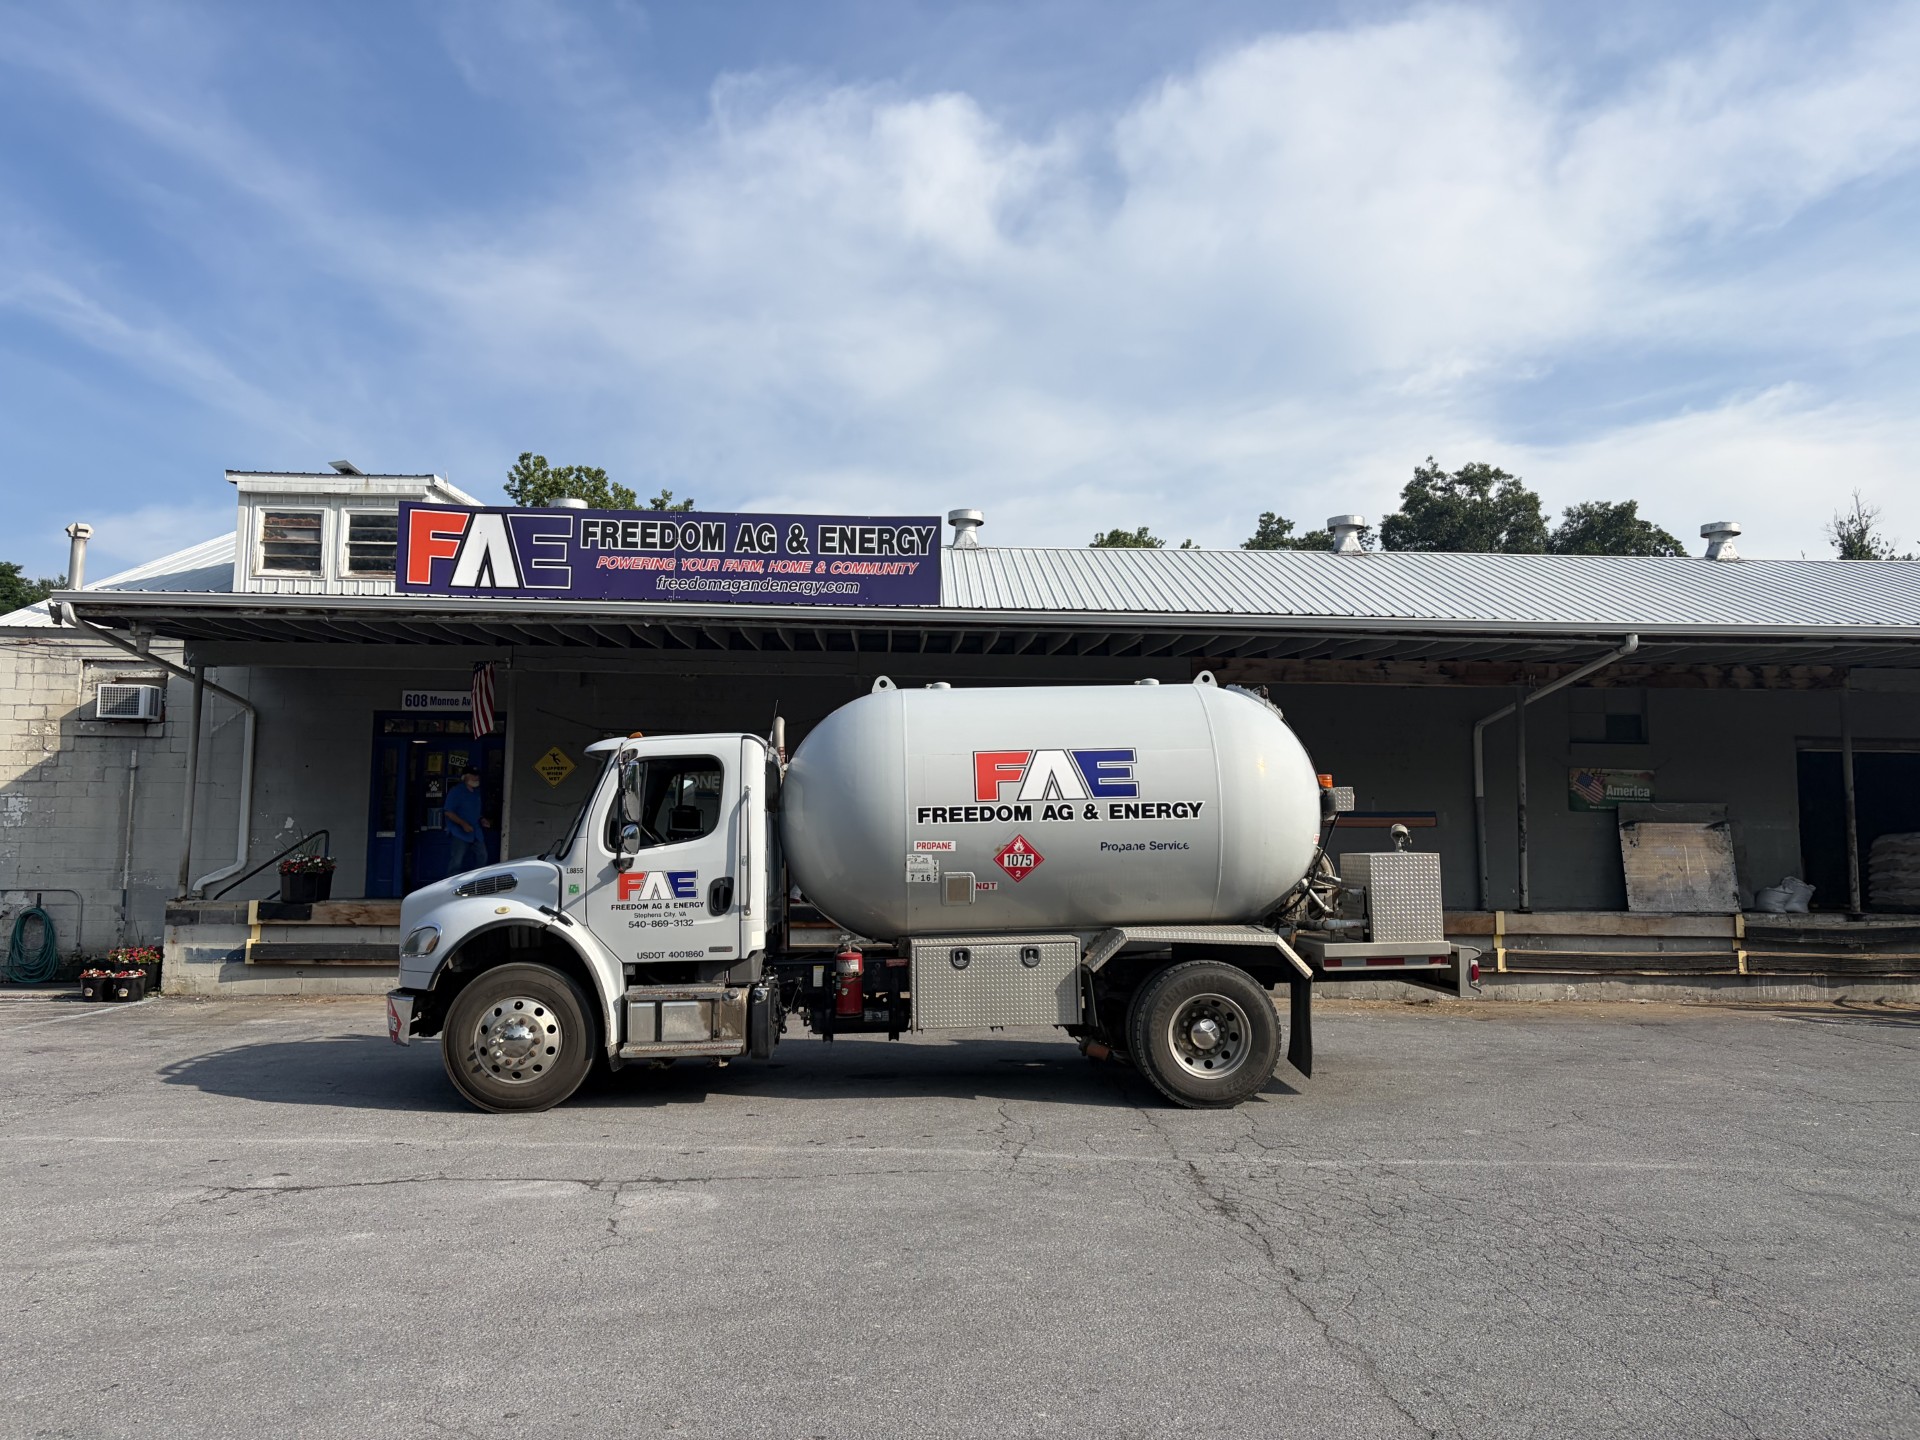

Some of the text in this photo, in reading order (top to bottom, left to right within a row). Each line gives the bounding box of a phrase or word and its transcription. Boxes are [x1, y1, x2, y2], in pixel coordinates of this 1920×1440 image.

[580, 518, 936, 556] FREEDOM AG & ENERGY
[406, 508, 574, 590] FAE
[596, 555, 919, 575] POWERING YOUR FARM, HOME & COMMUNITY
[656, 574, 859, 595] freedomagandenergy.com
[405, 693, 473, 708] 608 Monroe Av
[972, 747, 1140, 802] FAE
[1606, 784, 1650, 797] America
[916, 800, 1205, 825] FREEDOM AG & ENERGY
[916, 841, 952, 850] PROPANE
[1100, 840, 1190, 852] Propane Service
[1006, 854, 1032, 867] 1075
[618, 870, 698, 901] FAE
[610, 902, 649, 911] FREEDOM
[651, 902, 662, 910] AG
[673, 901, 704, 909] ENERGY
[628, 919, 694, 929] 540-869-3132
[637, 950, 704, 959] USDOT 4001860
